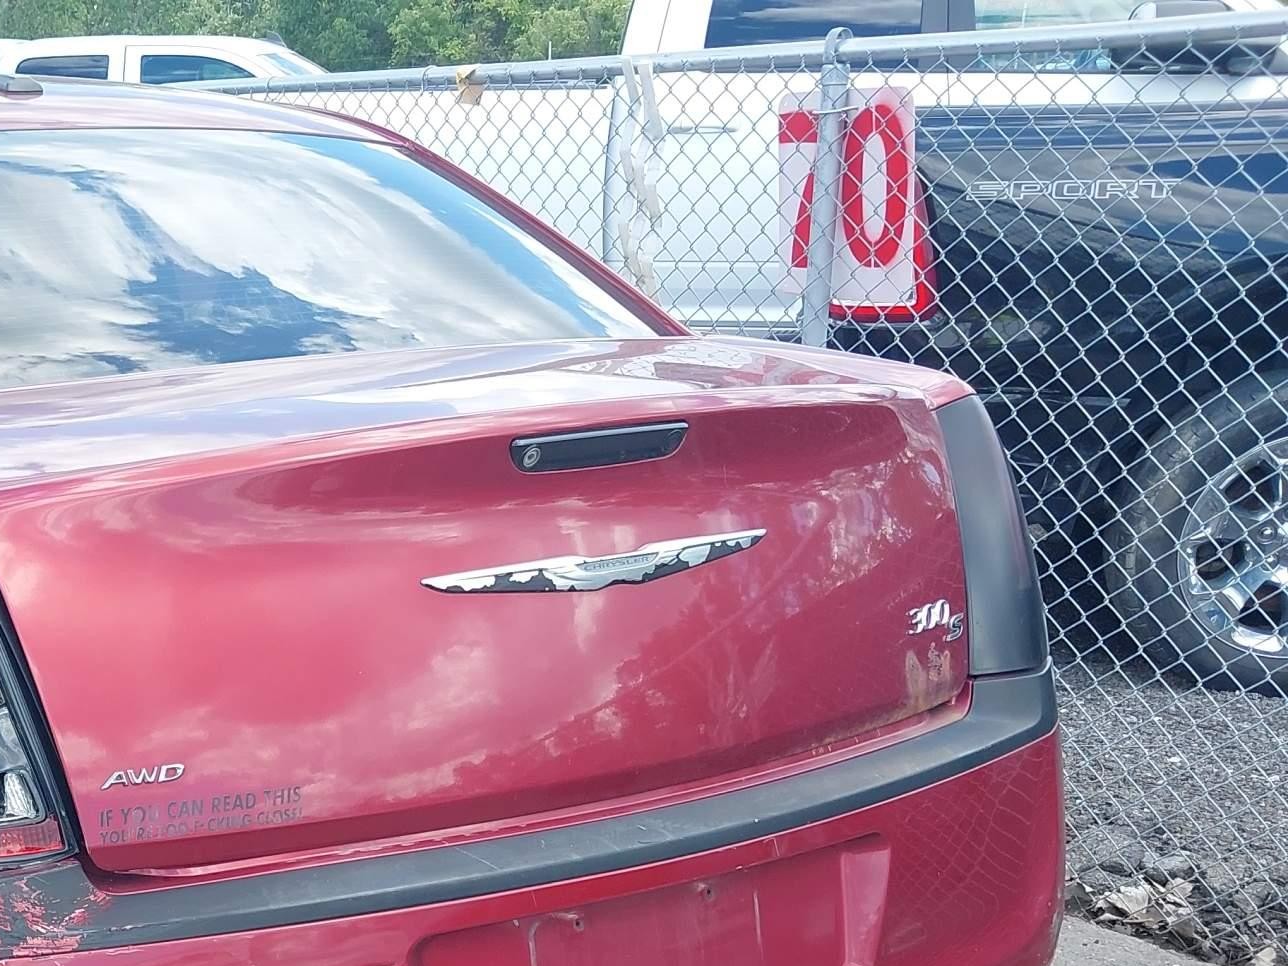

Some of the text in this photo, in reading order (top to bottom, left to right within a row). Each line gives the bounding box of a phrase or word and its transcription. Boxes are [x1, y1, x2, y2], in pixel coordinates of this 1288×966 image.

[966, 178, 1185, 201] SPORT
[583, 555, 650, 571] CHRYSLER
[99, 763, 186, 791] AWD
[99, 786, 302, 828] IF YOU CAN READ THIS
